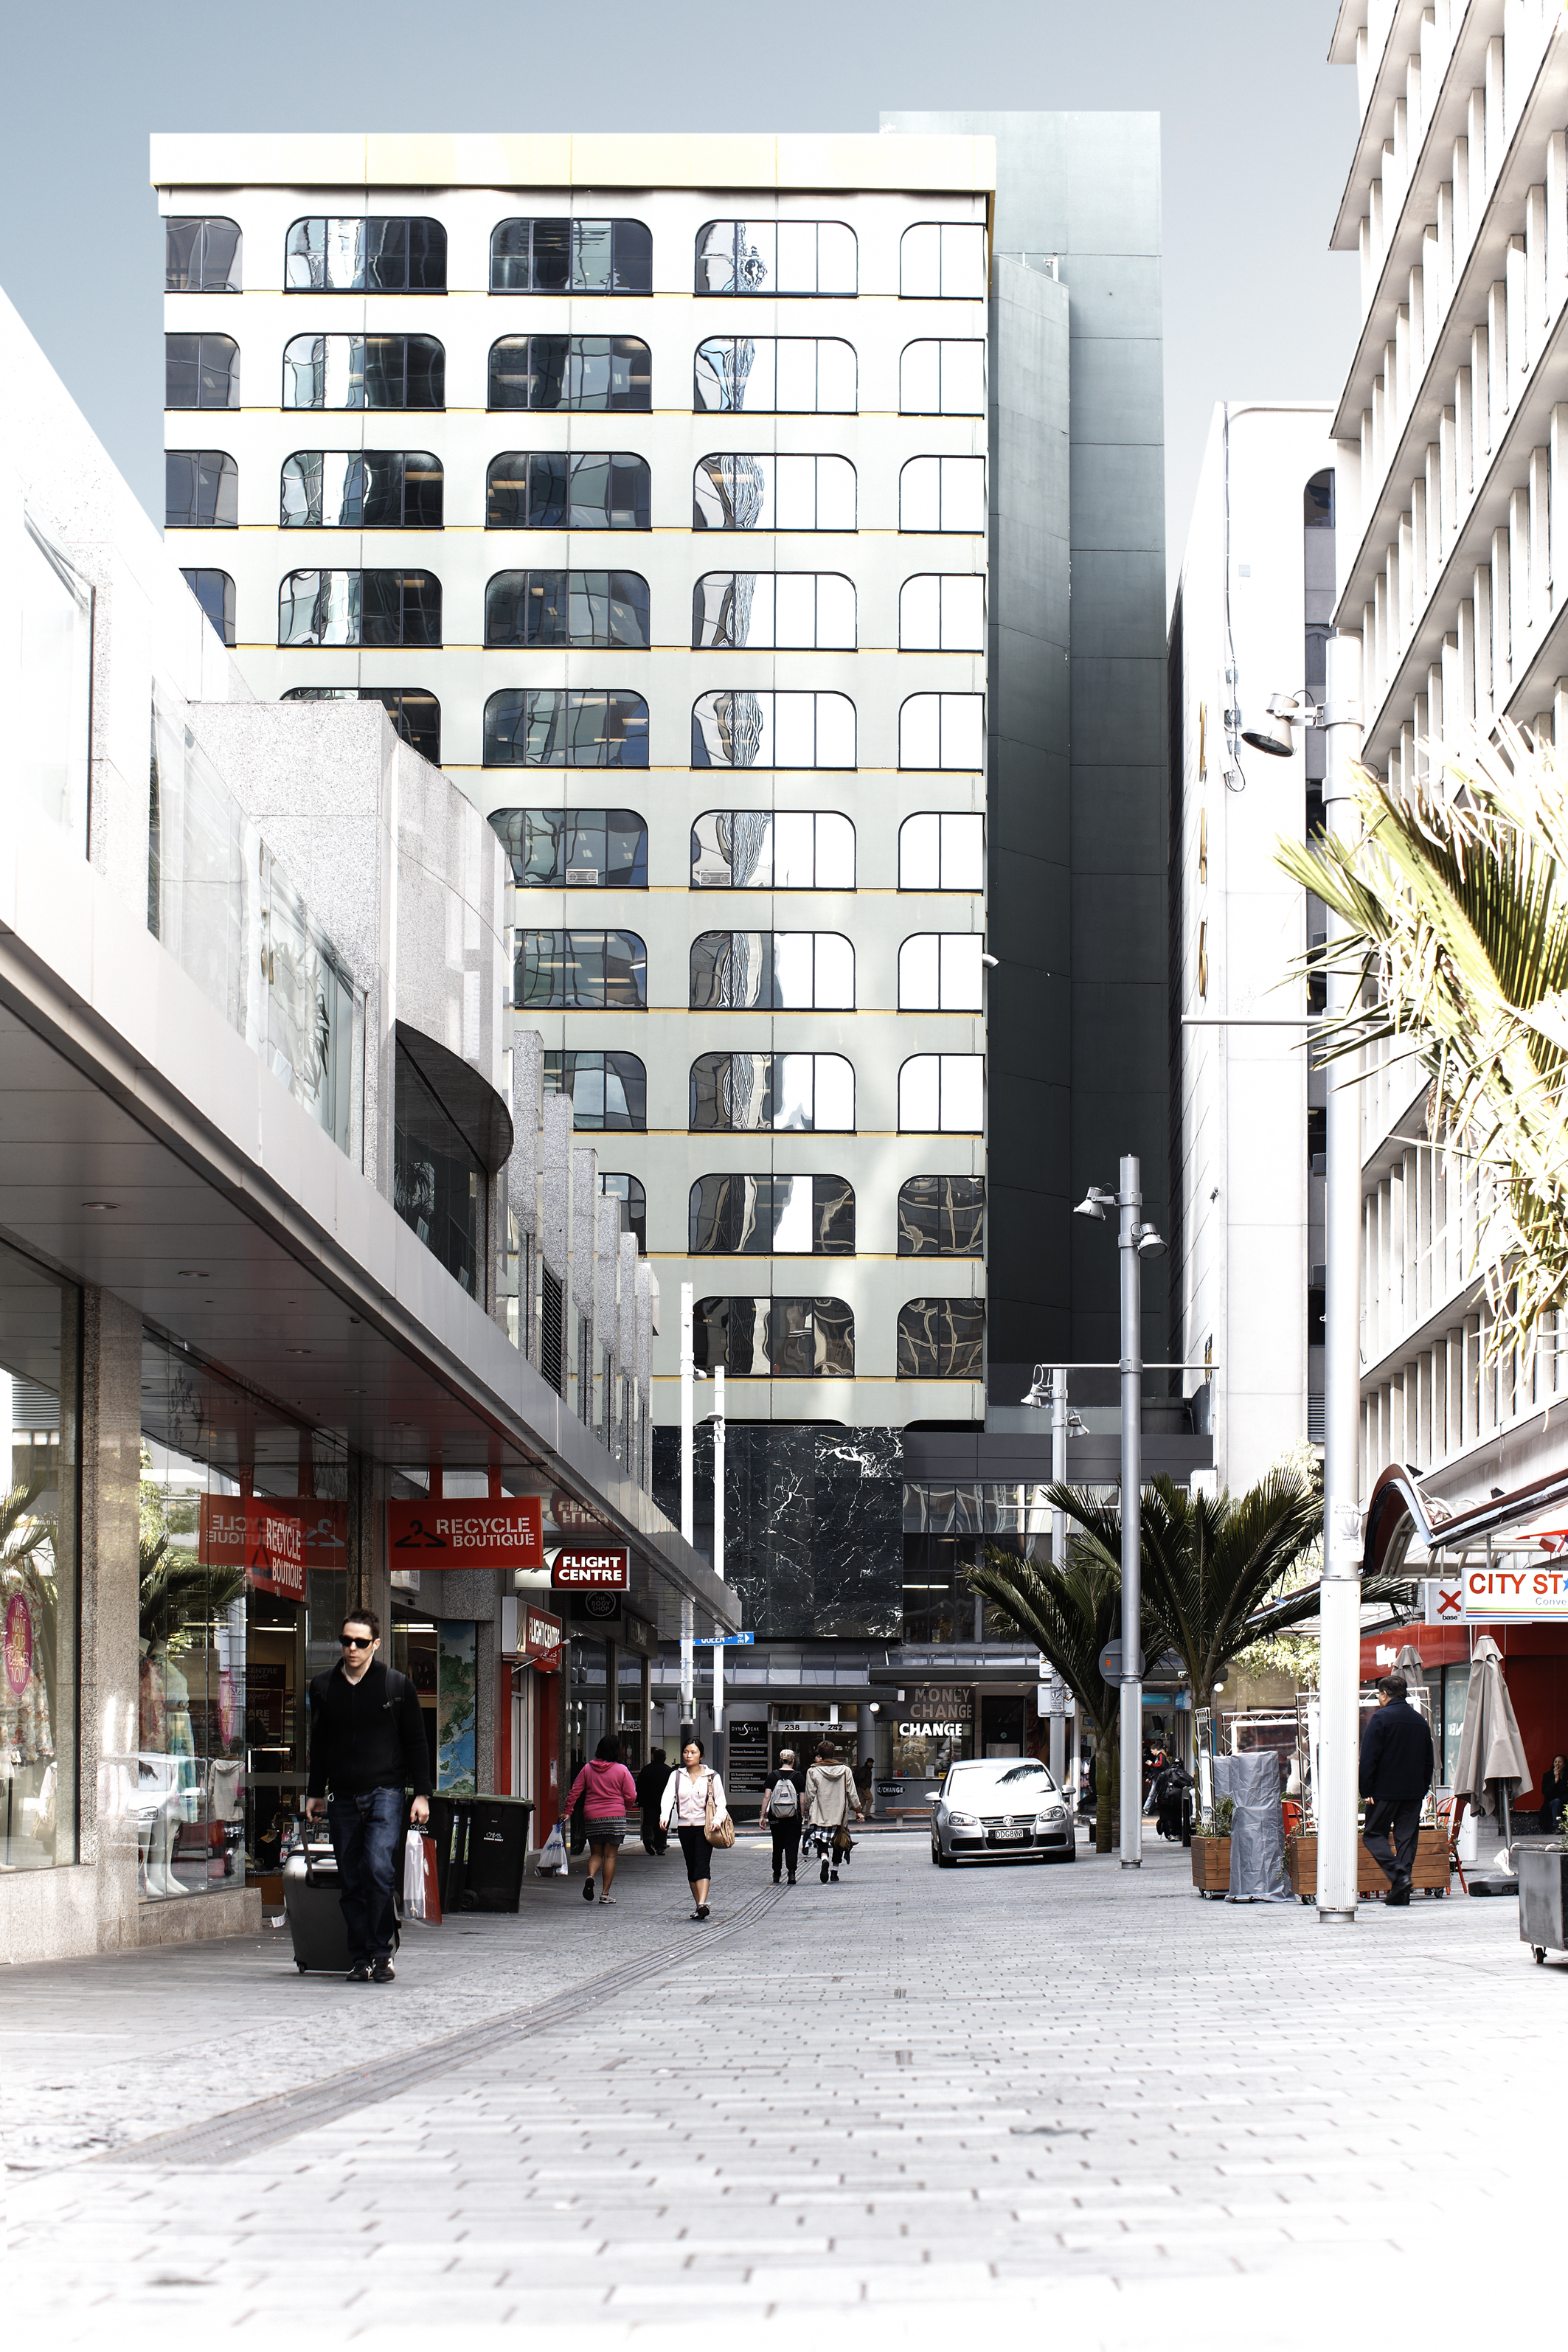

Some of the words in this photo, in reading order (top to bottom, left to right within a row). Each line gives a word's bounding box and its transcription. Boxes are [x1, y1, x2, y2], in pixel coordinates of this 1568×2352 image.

[436, 1517, 530, 1535] RECYCLE
[266, 1517, 301, 1561] RECYCLE
[453, 1533, 535, 1547] BOUTIQUE
[562, 1556, 621, 1568] FLIGHT
[272, 1557, 302, 1589] BOUTIQUE
[558, 1569, 622, 1581] CENTRE
[1469, 1573, 1527, 1595] CITY
[529, 1617, 545, 1646] FLIGHT
[915, 1688, 970, 1703] MONEY
[910, 1704, 972, 1718] CHANGE
[899, 1722, 962, 1736] CHANGE
[996, 1830, 1023, 1839] DDG800
